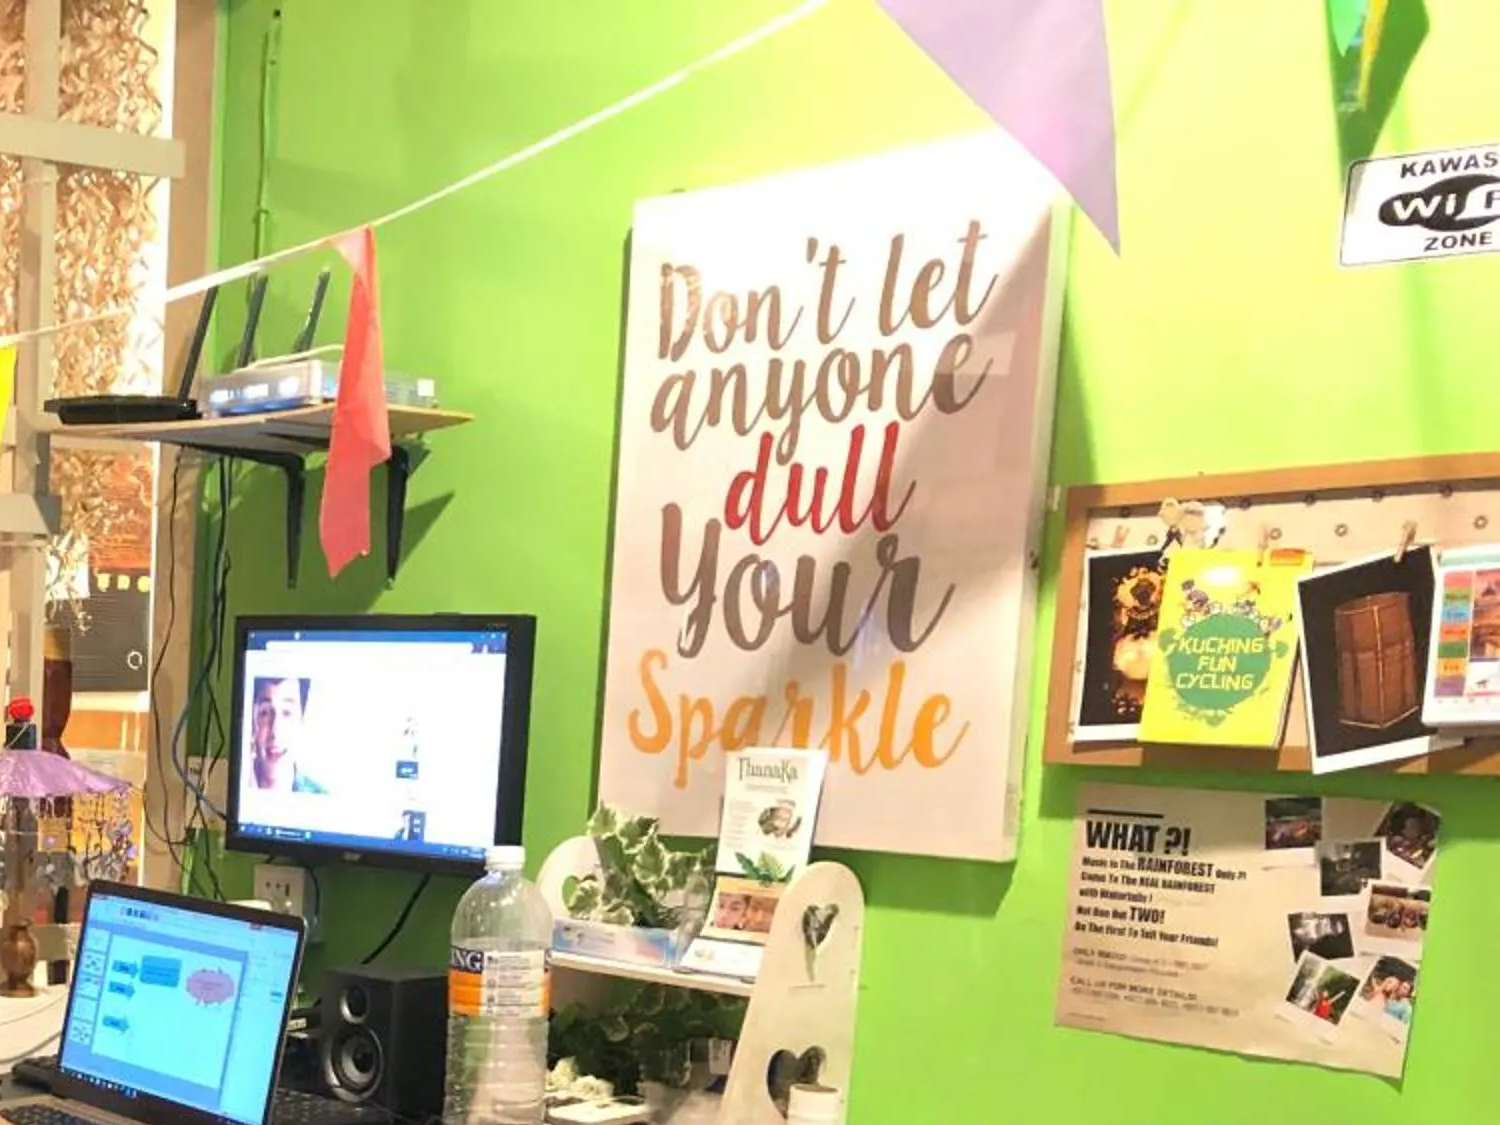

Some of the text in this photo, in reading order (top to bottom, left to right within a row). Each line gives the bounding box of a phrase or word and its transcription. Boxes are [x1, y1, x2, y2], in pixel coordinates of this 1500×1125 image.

[1400, 152, 1499, 179] KAWAS
[1424, 232, 1492, 252] ZONE
[658, 220, 998, 362] Don't let
[650, 333, 993, 465] anyone
[725, 421, 917, 546] dull
[660, 502, 956, 658] Your
[1179, 637, 1265, 654] KUCHING
[1197, 655, 1237, 672] FUN
[1176, 672, 1254, 691] CYCLING
[627, 648, 970, 789] Sparkle
[1086, 820, 1192, 856] WHAT ?!
[1137, 857, 1214, 878] RAINFOREST
[1161, 879, 1216, 894] RAINFOREST
[1129, 906, 1166, 924] TWO!
